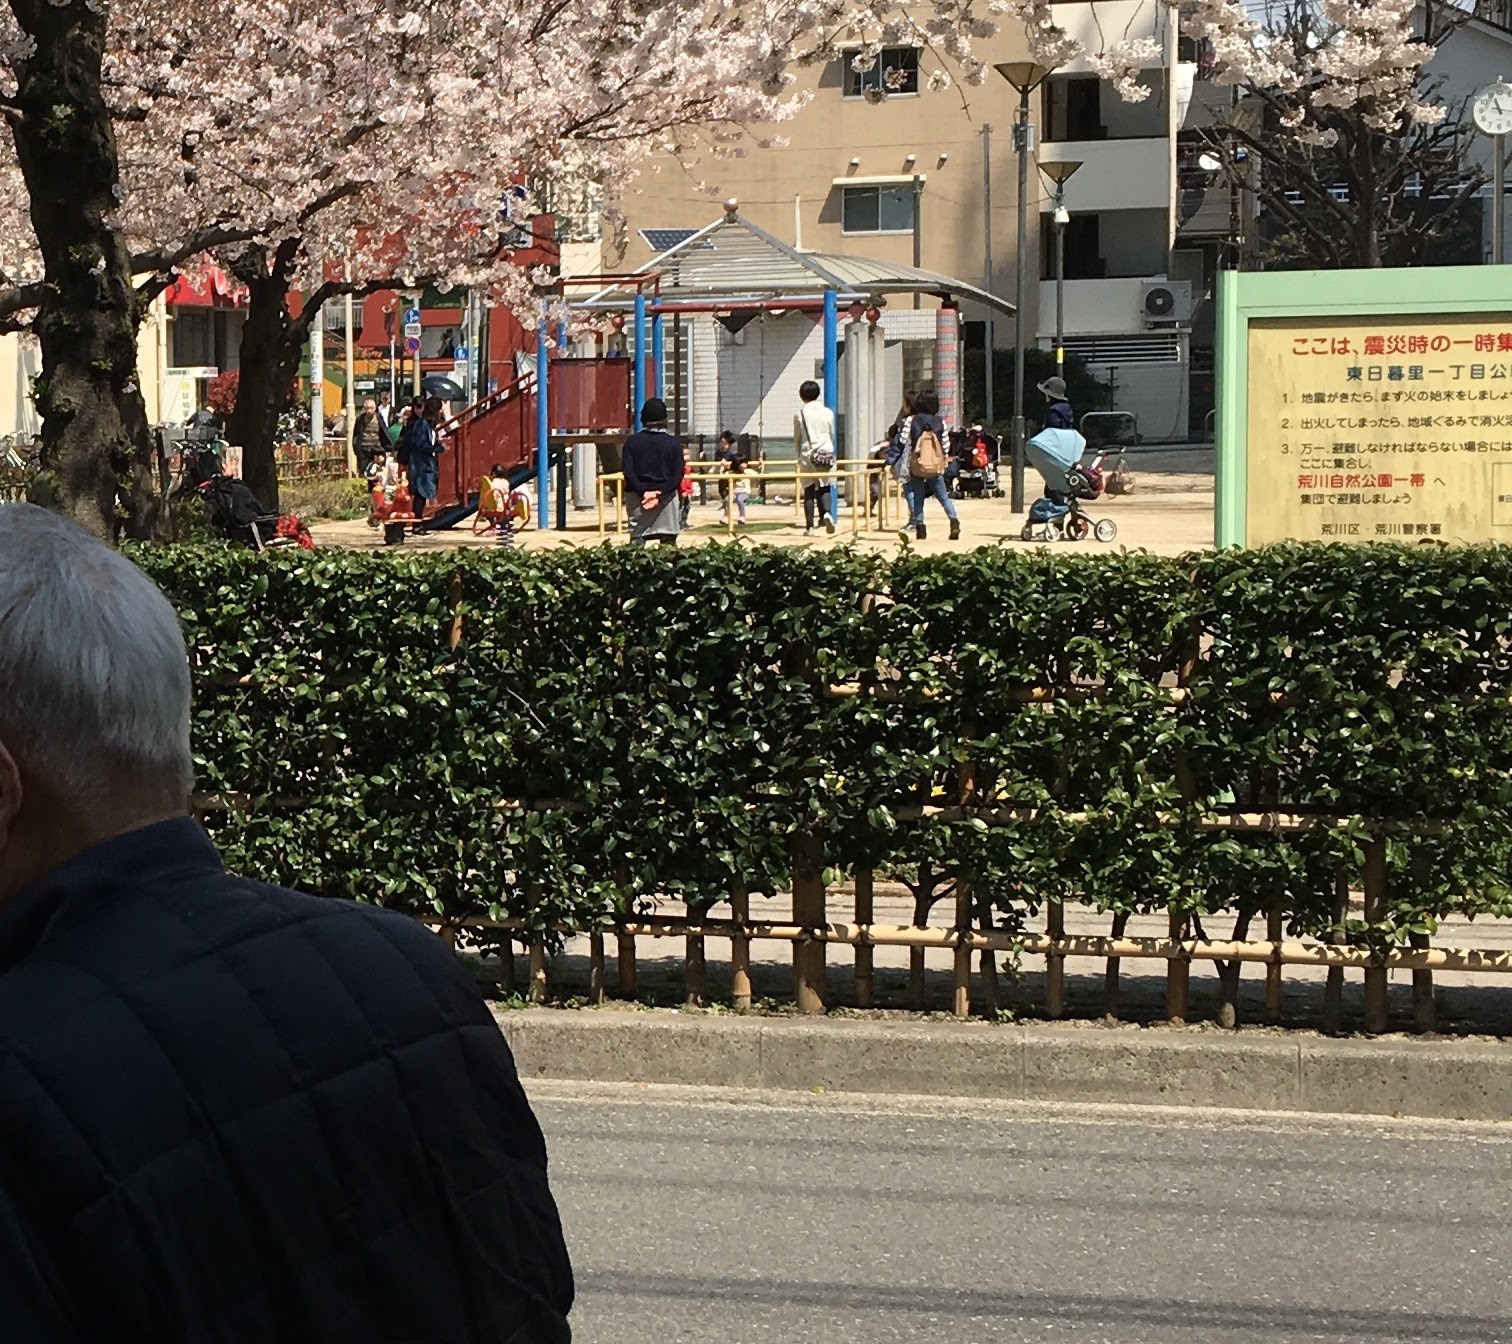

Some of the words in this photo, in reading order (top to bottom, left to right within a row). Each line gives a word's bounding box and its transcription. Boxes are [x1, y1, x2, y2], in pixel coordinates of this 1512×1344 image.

[1292, 333, 1512, 355] ここは、震災時の一時集
[1346, 363, 1512, 382] 東日暮里一丁目公
[1301, 389, 1512, 404] 地震がきたら、まず火の始末をしましょ
[1297, 473, 1426, 489] 荒川自然公園一帯
[1300, 492, 1412, 505] 集団で避難しましょう
